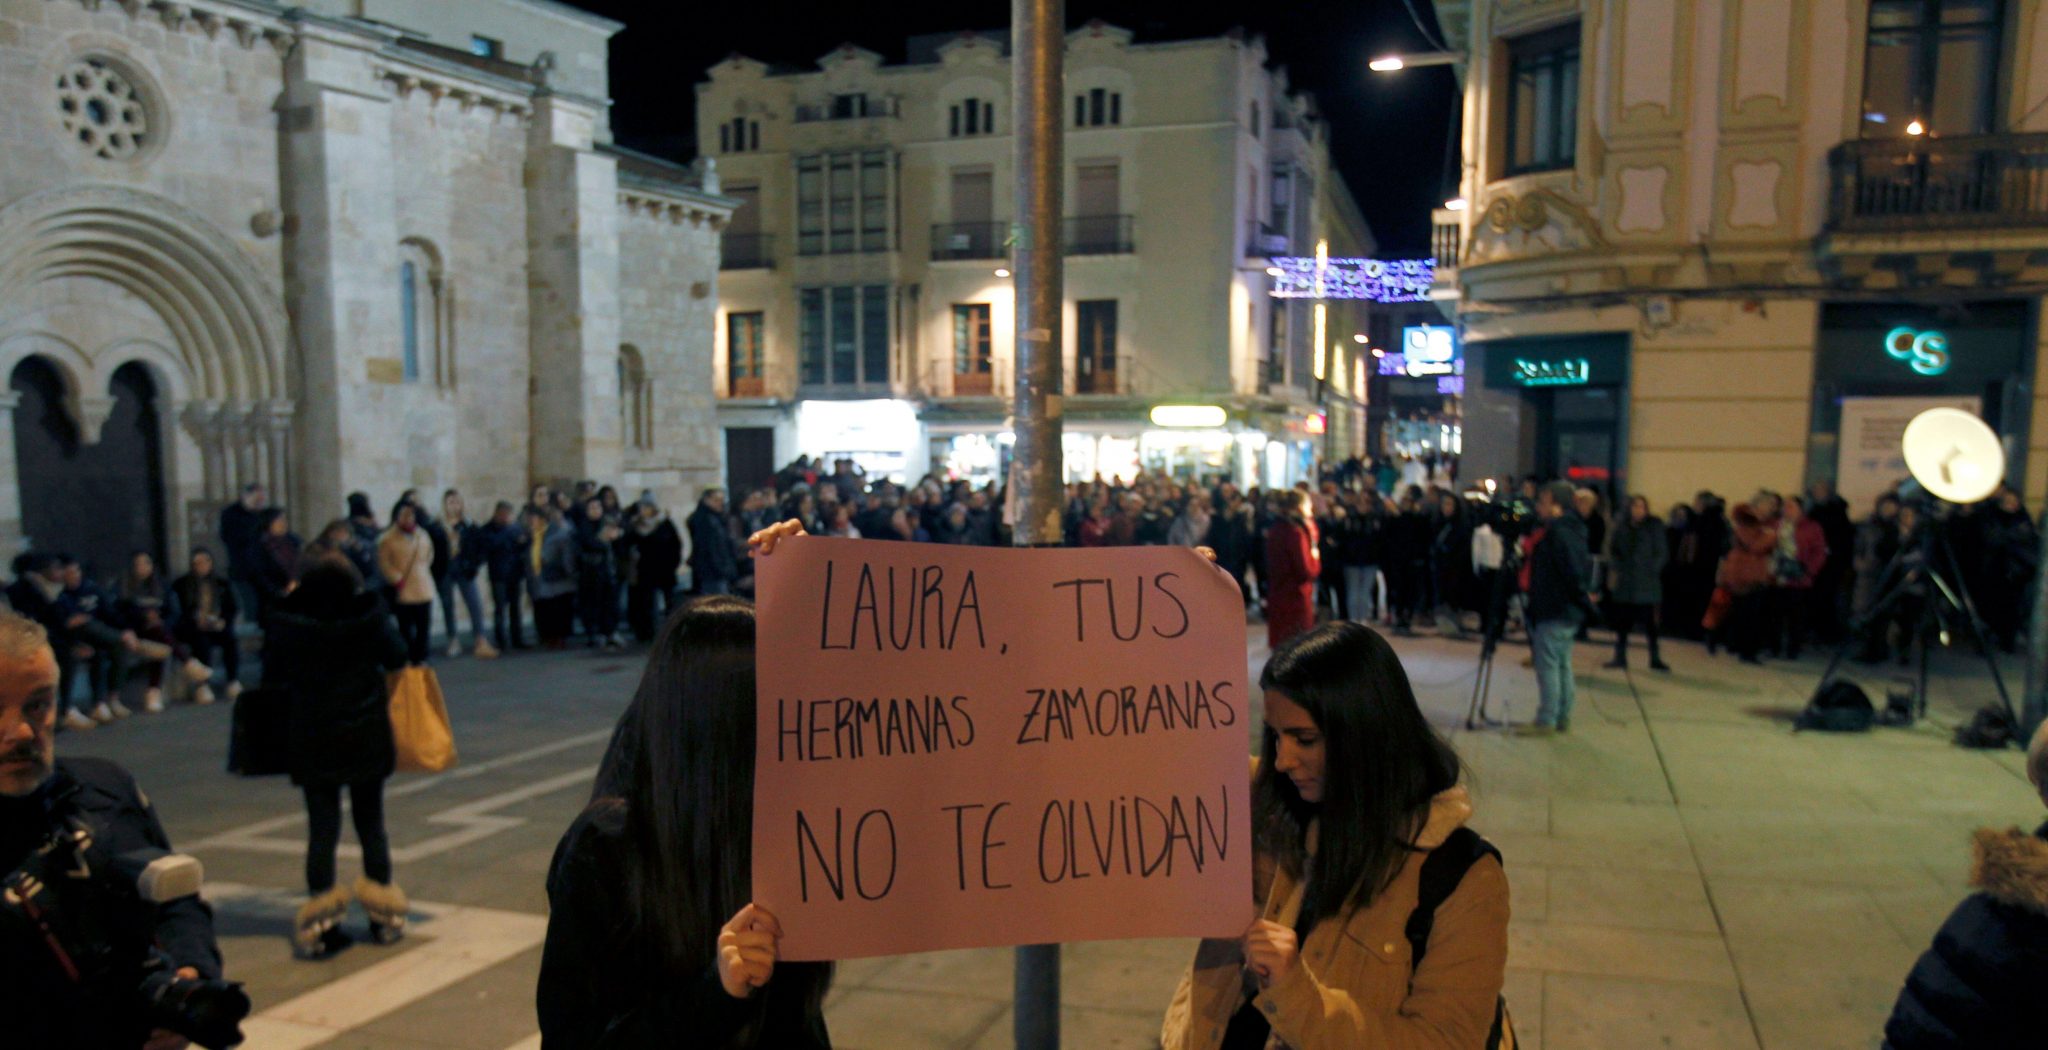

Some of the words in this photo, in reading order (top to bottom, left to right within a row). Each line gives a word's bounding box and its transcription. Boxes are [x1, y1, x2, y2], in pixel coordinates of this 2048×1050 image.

[820, 559, 1009, 656] LAURA,
[1052, 571, 1190, 643] TUS
[777, 694, 975, 763] HERMANAS
[1016, 679, 1236, 746] ZAMORANAS
[795, 807, 898, 904] NO
[941, 801, 1012, 891] TE
